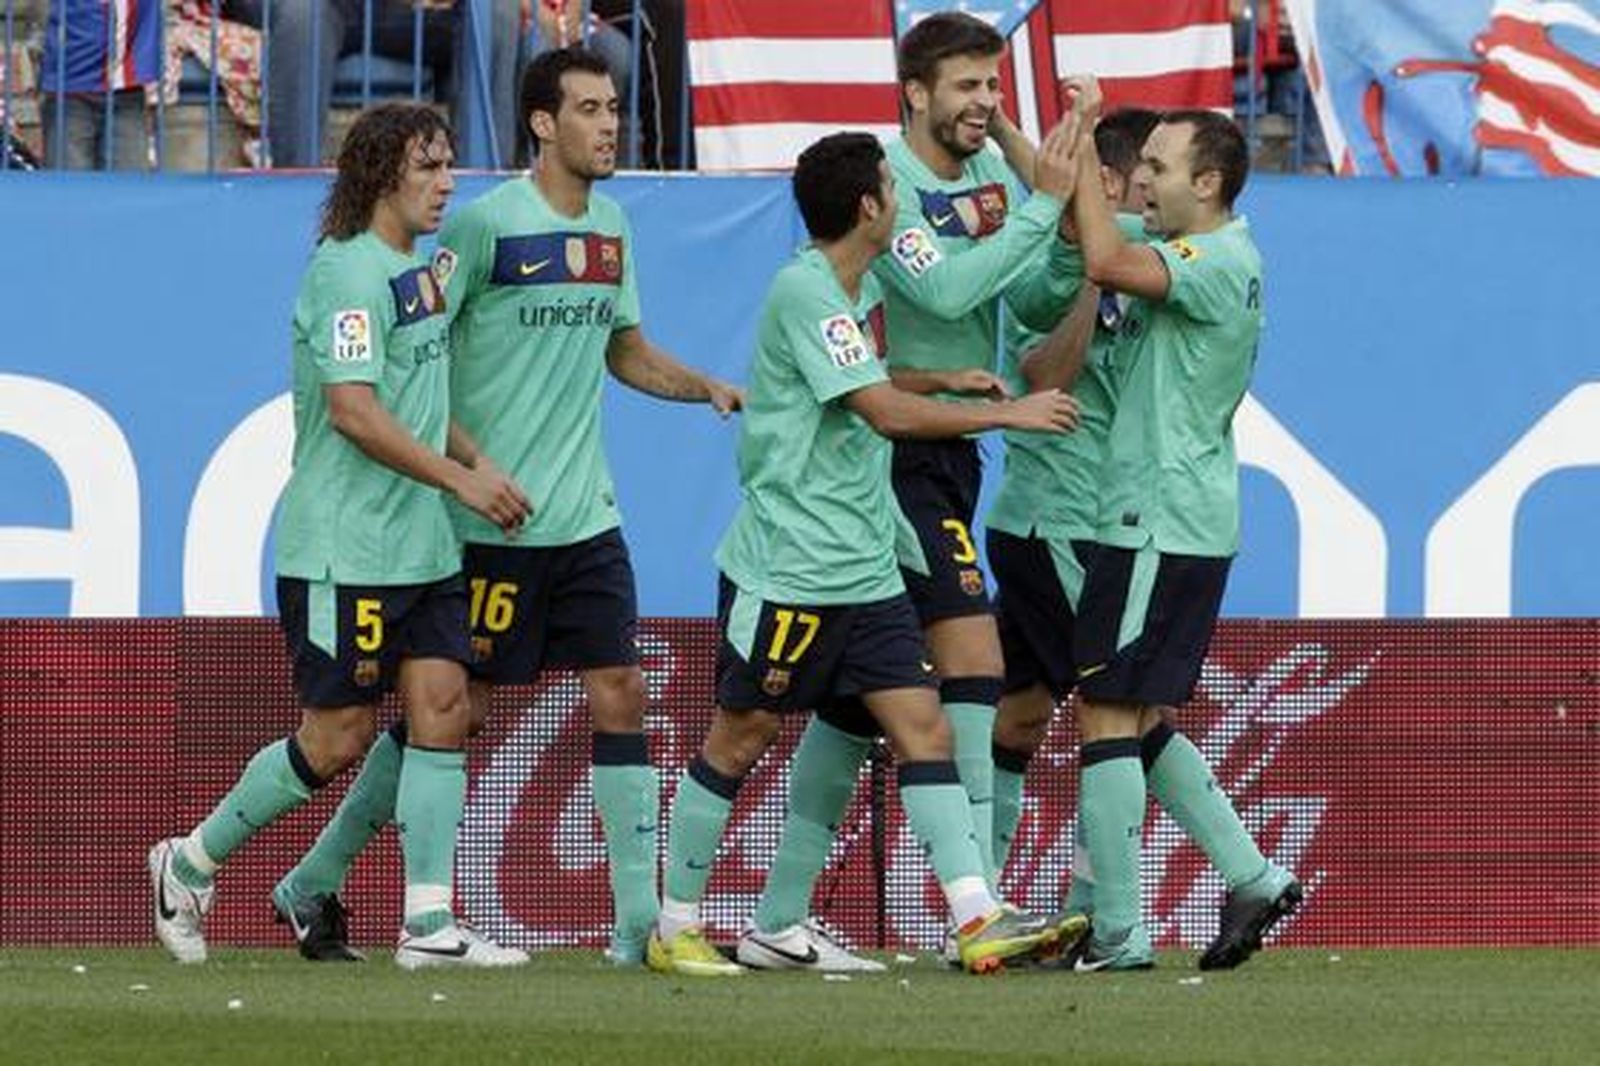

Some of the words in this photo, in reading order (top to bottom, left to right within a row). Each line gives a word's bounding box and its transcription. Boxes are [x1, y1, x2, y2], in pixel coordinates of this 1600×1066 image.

[910, 250, 935, 274] LFP
[518, 296, 595, 327] unicef
[834, 347, 864, 367] LFP
[942, 518, 977, 563] 3
[355, 598, 383, 651] 5
[469, 578, 518, 632] 16
[767, 609, 821, 663] 17
